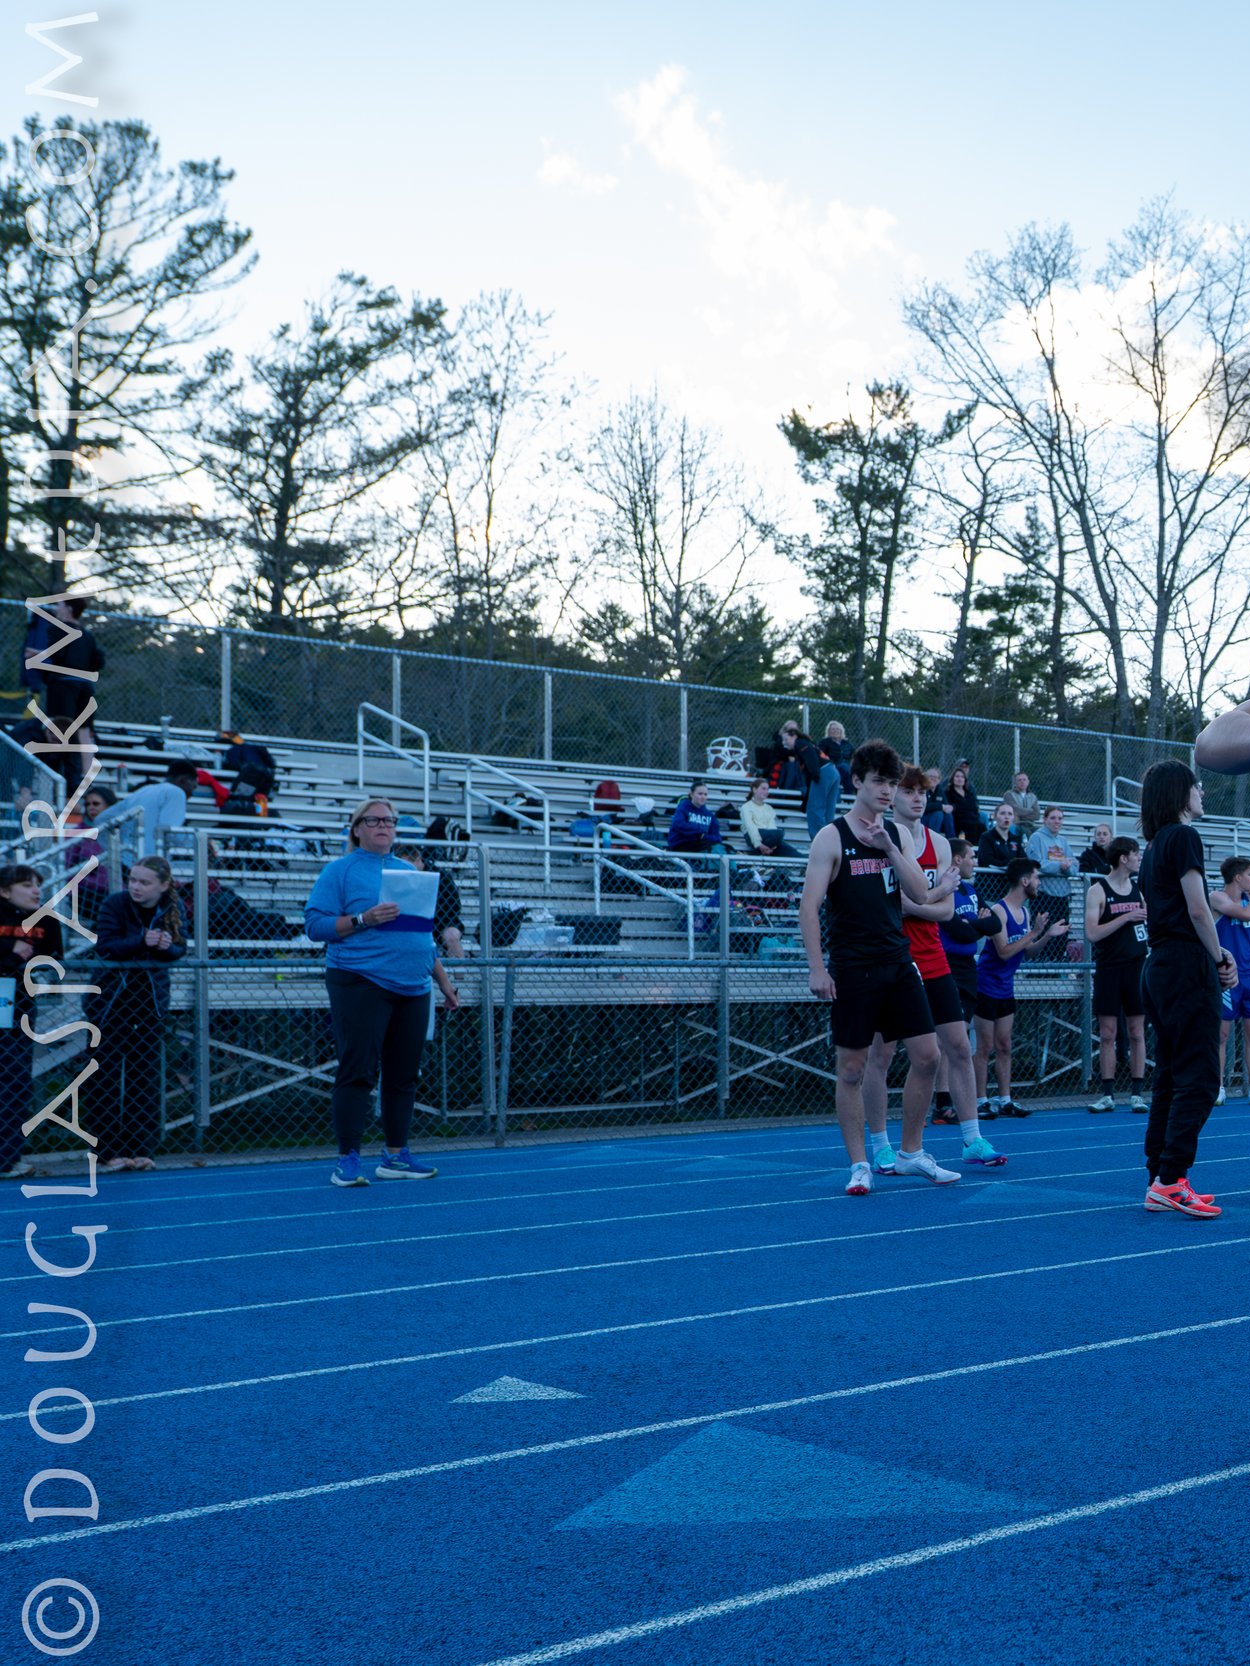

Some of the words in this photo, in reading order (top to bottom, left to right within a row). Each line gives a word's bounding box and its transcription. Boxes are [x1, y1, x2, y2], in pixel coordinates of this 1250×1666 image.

[889, 868, 897, 890] 4
[926, 871, 935, 890] 3
[1137, 926, 1145, 939] 5
